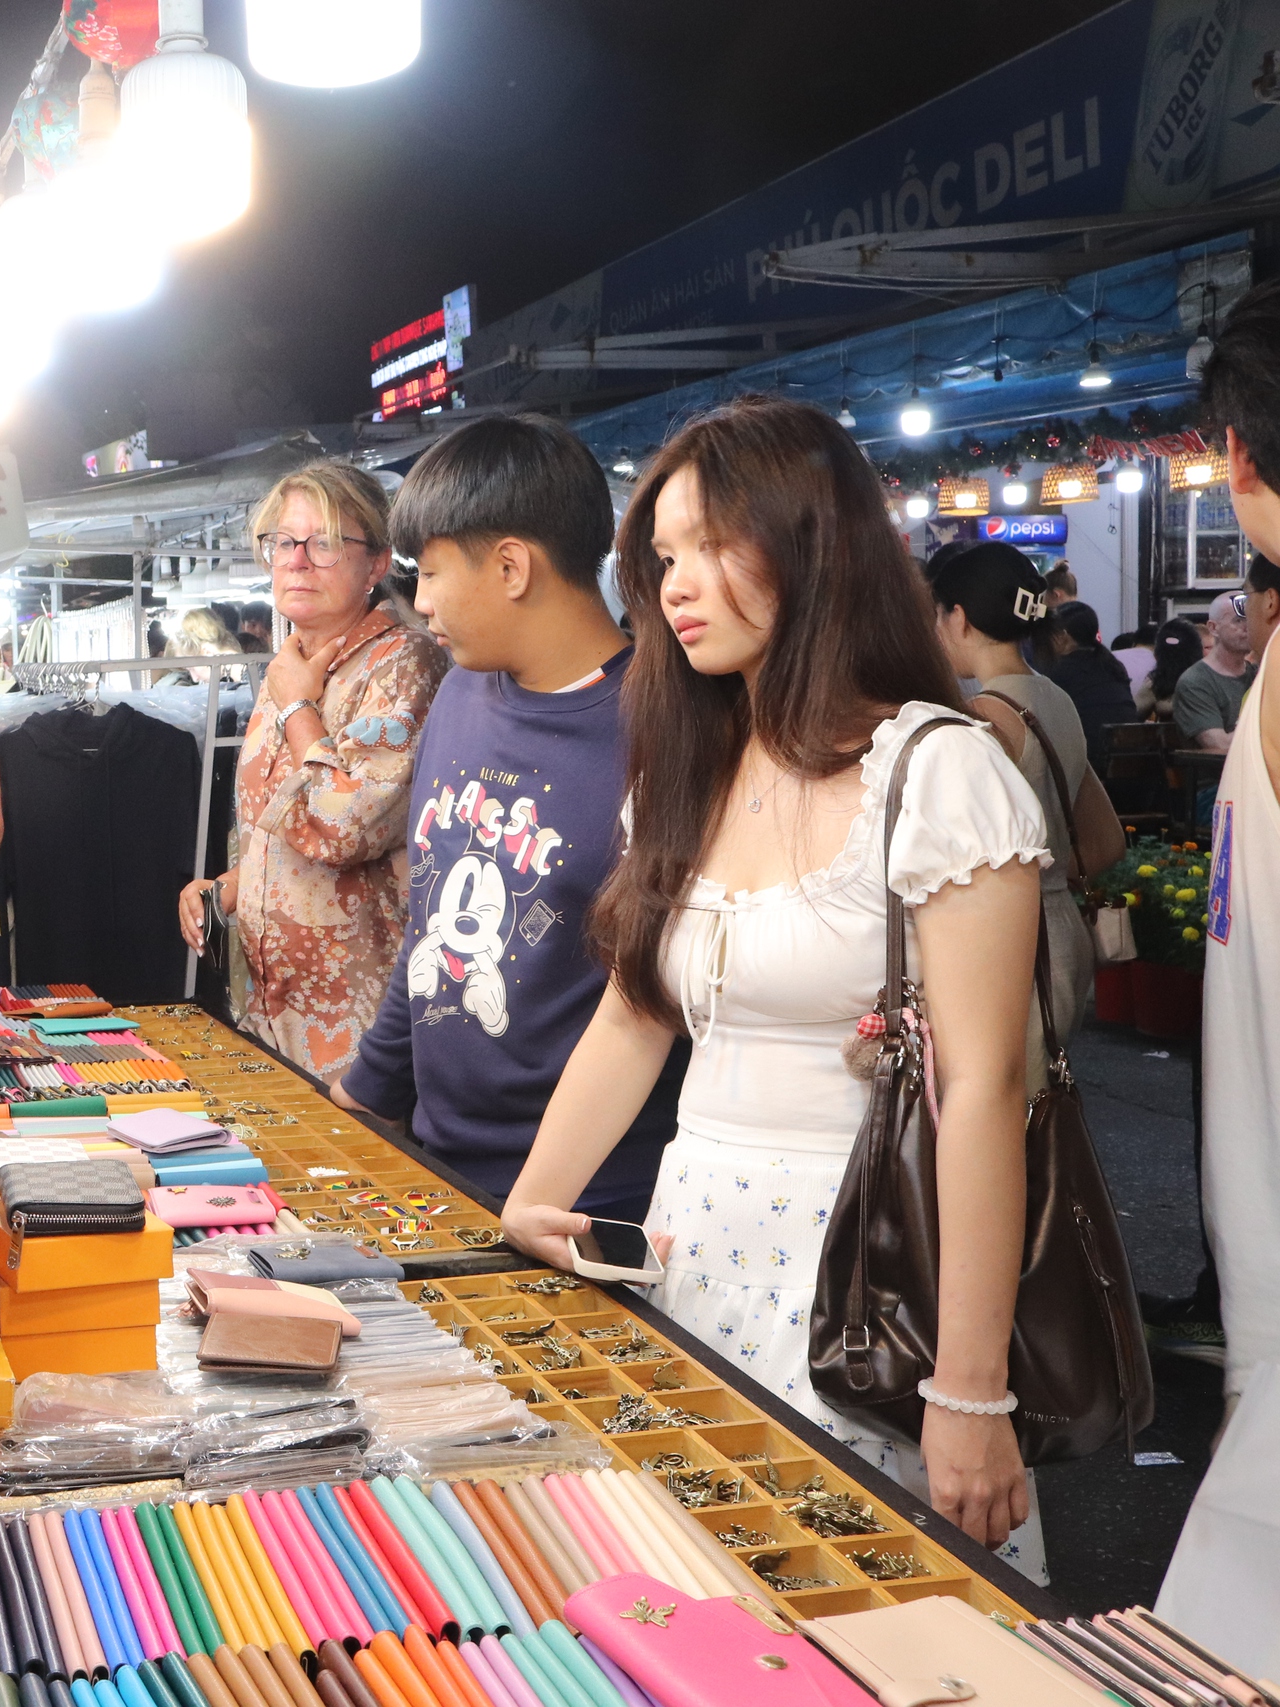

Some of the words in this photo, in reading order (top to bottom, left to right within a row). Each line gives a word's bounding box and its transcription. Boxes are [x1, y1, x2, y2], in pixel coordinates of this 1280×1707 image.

[1142, 20, 1225, 175] TUBORG
[1183, 100, 1208, 142] ICE
[973, 94, 1102, 214] DELI
[1010, 520, 1055, 538] pepsi
[479, 767, 520, 787] ALL-TIME
[414, 780, 563, 876] CLASSIC
